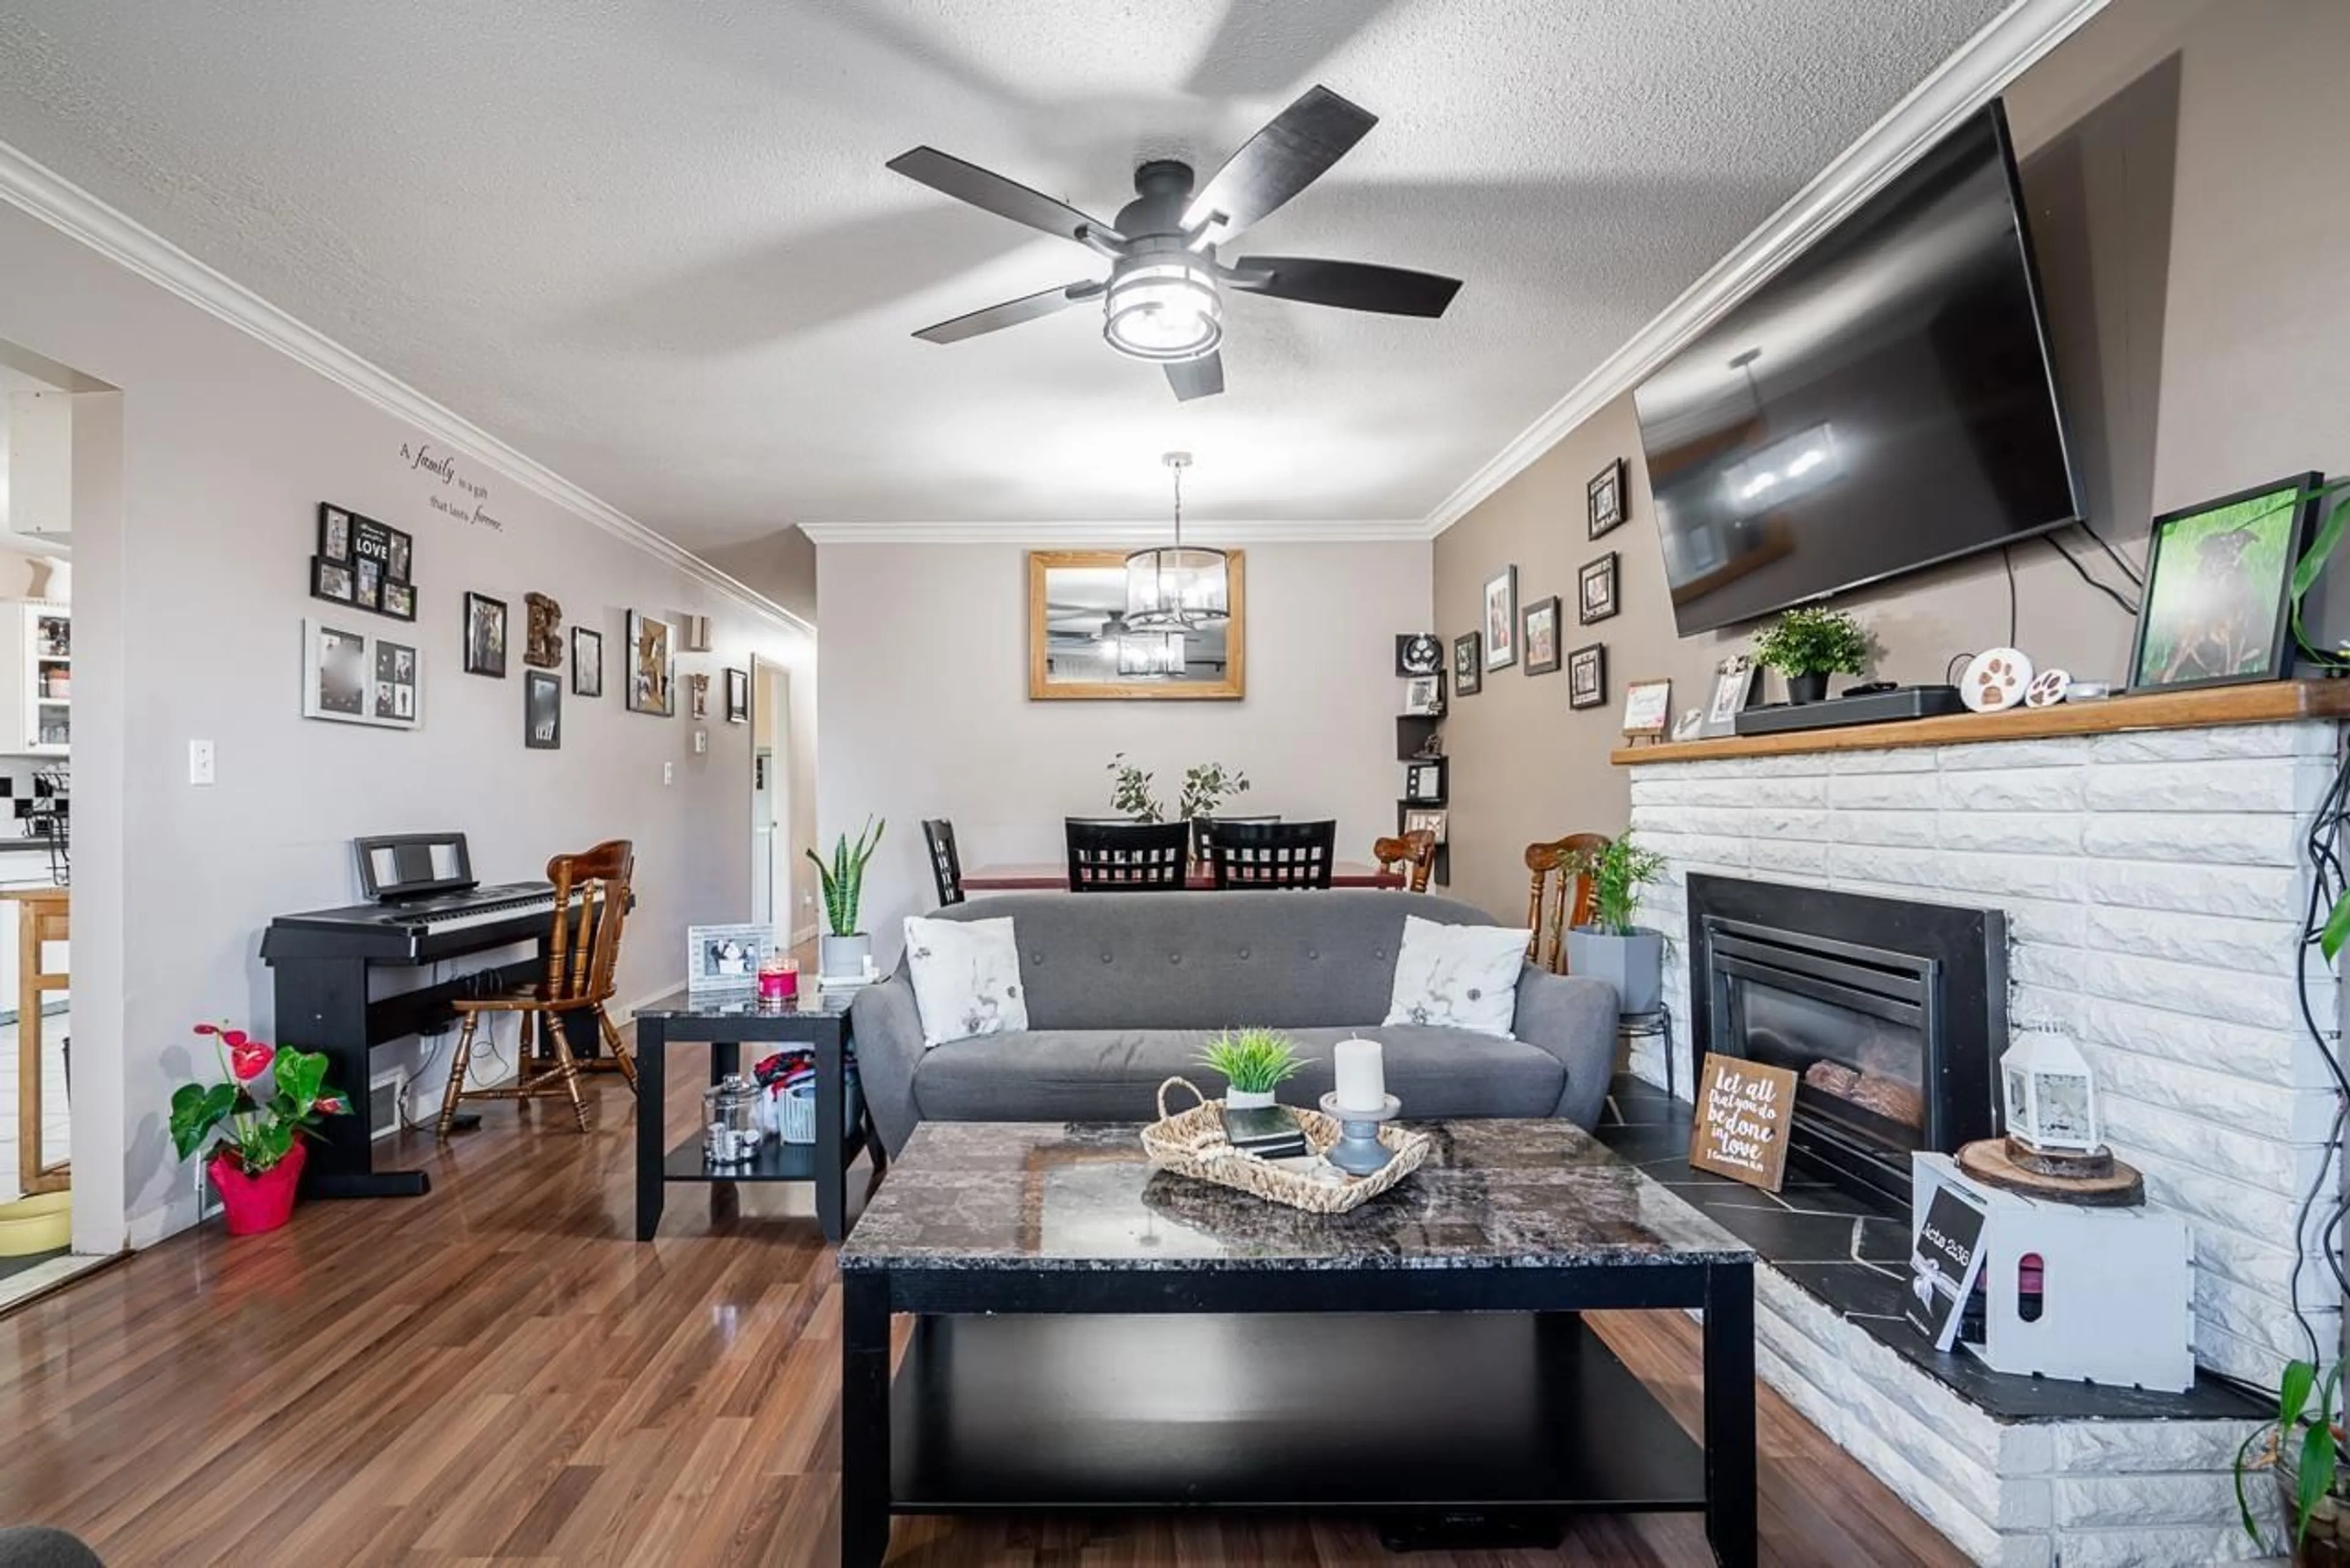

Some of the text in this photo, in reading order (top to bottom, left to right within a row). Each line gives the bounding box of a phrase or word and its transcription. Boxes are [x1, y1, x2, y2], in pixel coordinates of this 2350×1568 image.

[400, 442, 410, 460] A
[411, 444, 454, 485] family
[356, 538, 387, 560] LOVE
[1746, 1079, 1776, 1102] all
[1758, 1102, 1777, 1119] do
[1707, 1102, 1774, 1143] be done
[1710, 1123, 1724, 1140] in
[1922, 1222, 1946, 1249] Acts
